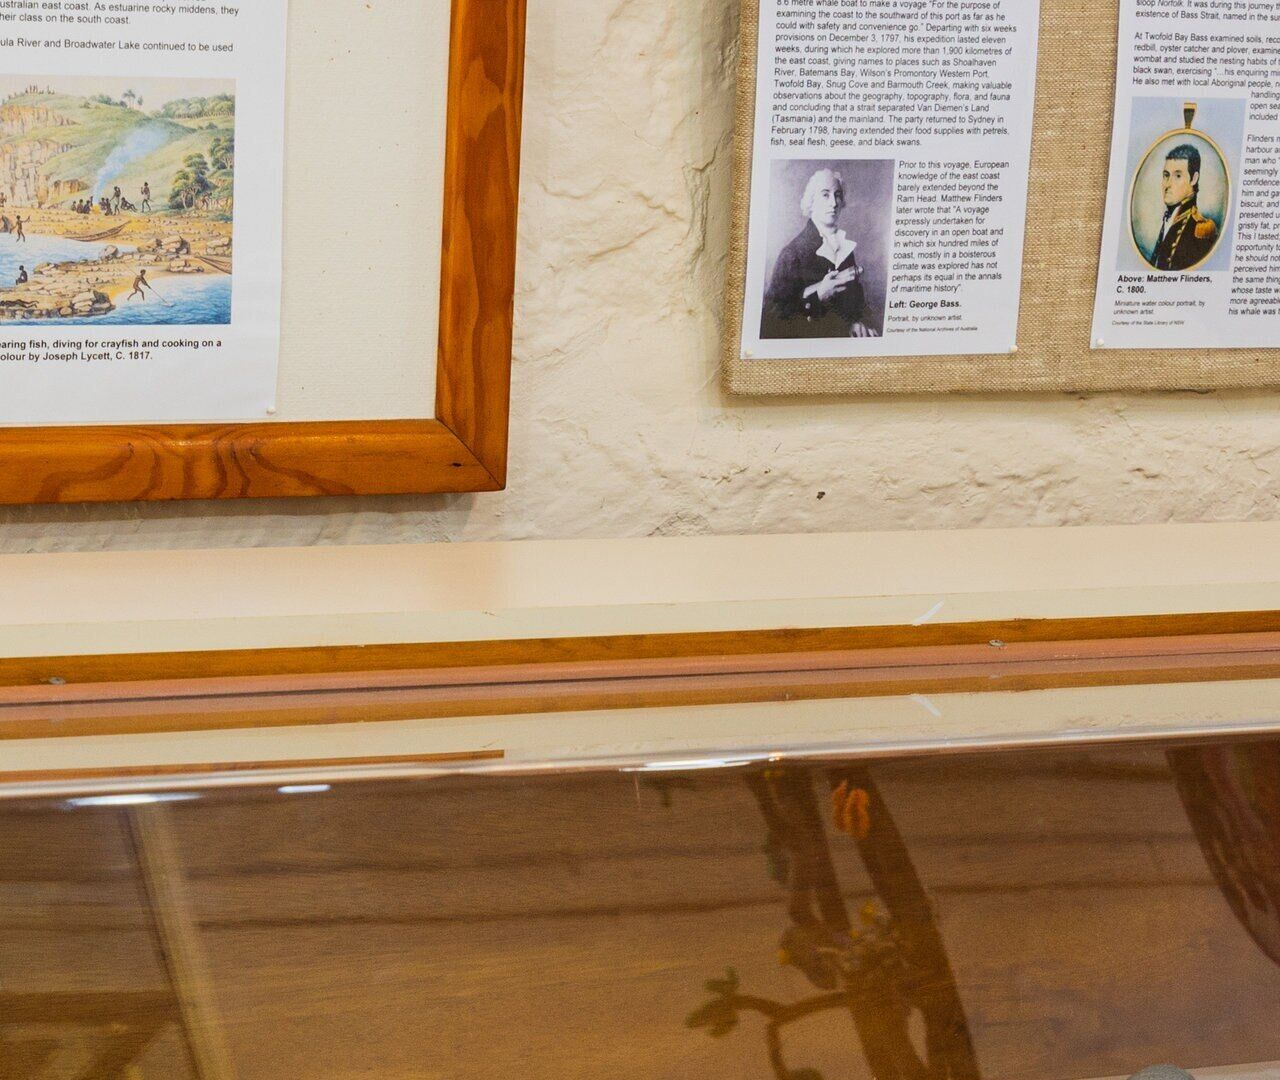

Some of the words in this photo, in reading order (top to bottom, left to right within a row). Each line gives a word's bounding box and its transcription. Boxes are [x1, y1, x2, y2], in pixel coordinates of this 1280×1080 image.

[19, 13, 42, 22] class
[60, 14, 74, 22] the
[77, 14, 101, 23] south
[17, 37, 40, 47] River
[44, 39, 61, 47] and
[64, 39, 115, 49] Broadwater
[118, 40, 139, 49] Lake
[142, 41, 185, 51] continued
[187, 43, 196, 51] to
[198, 42, 209, 51] be
[212, 42, 233, 52] used
[1247, 134, 1274, 142] Flinders
[899, 160, 916, 168] Prior
[974, 160, 1009, 169] European
[898, 172, 938, 181] knowledge
[939, 171, 947, 179] of
[897, 183, 920, 193] barely
[922, 183, 956, 191] extended
[958, 183, 985, 192] beyond
[1117, 274, 1144, 282] Above:
[1146, 274, 1178, 282] Matthew
[1180, 274, 1212, 282] Flinders,
[889, 300, 907, 308] Left:
[909, 300, 938, 309] George
[940, 299, 961, 307] Bass.
[29, 339, 49, 349] fish,
[52, 339, 81, 350] diving
[85, 339, 98, 348] for
[101, 339, 138, 349] crayfish
[141, 339, 159, 347] and
[161, 339, 199, 349] cooking
[28, 352, 39, 362] by
[43, 352, 77, 362] Joseph
[81, 351, 112, 362] Lycett,
[115, 351, 125, 359] C.
[129, 351, 152, 359] 1817.
